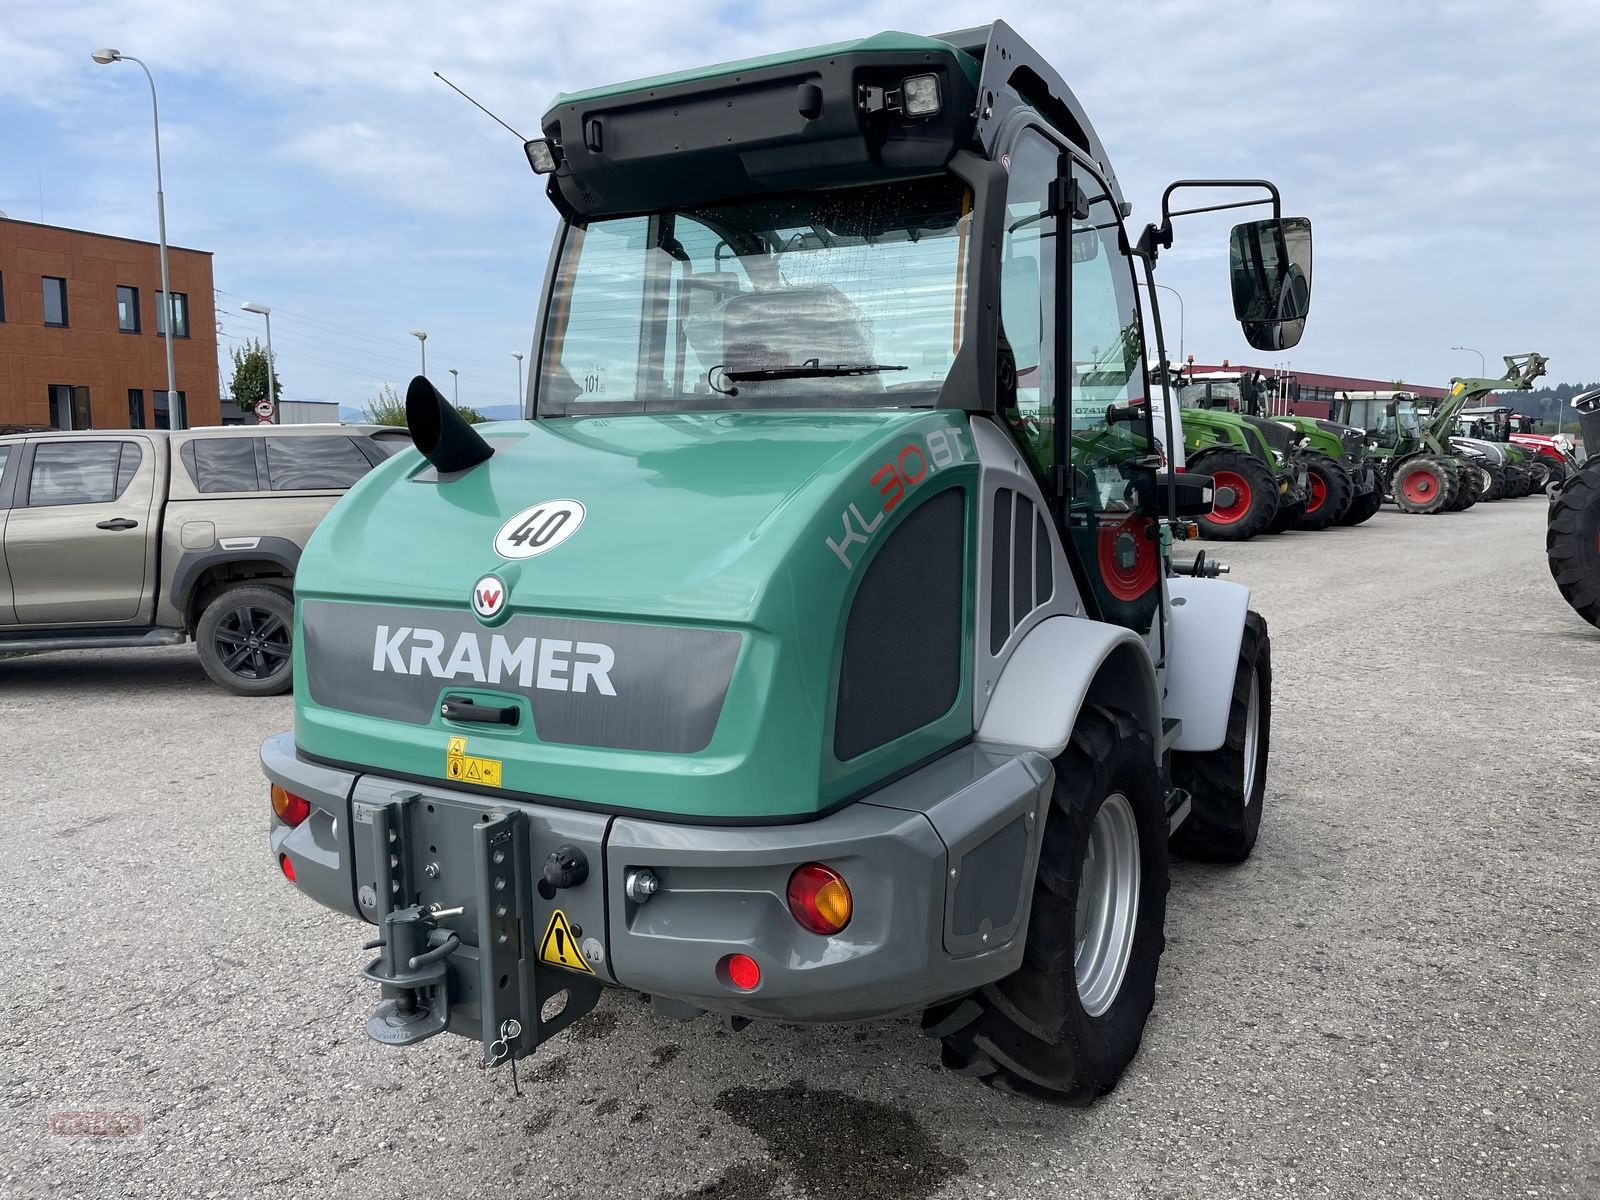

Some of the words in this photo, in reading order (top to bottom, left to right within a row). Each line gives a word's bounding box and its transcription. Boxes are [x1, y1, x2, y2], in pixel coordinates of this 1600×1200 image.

[584, 375, 599, 393] 101
[507, 509, 572, 547] 40
[372, 625, 617, 697] KRAMER
